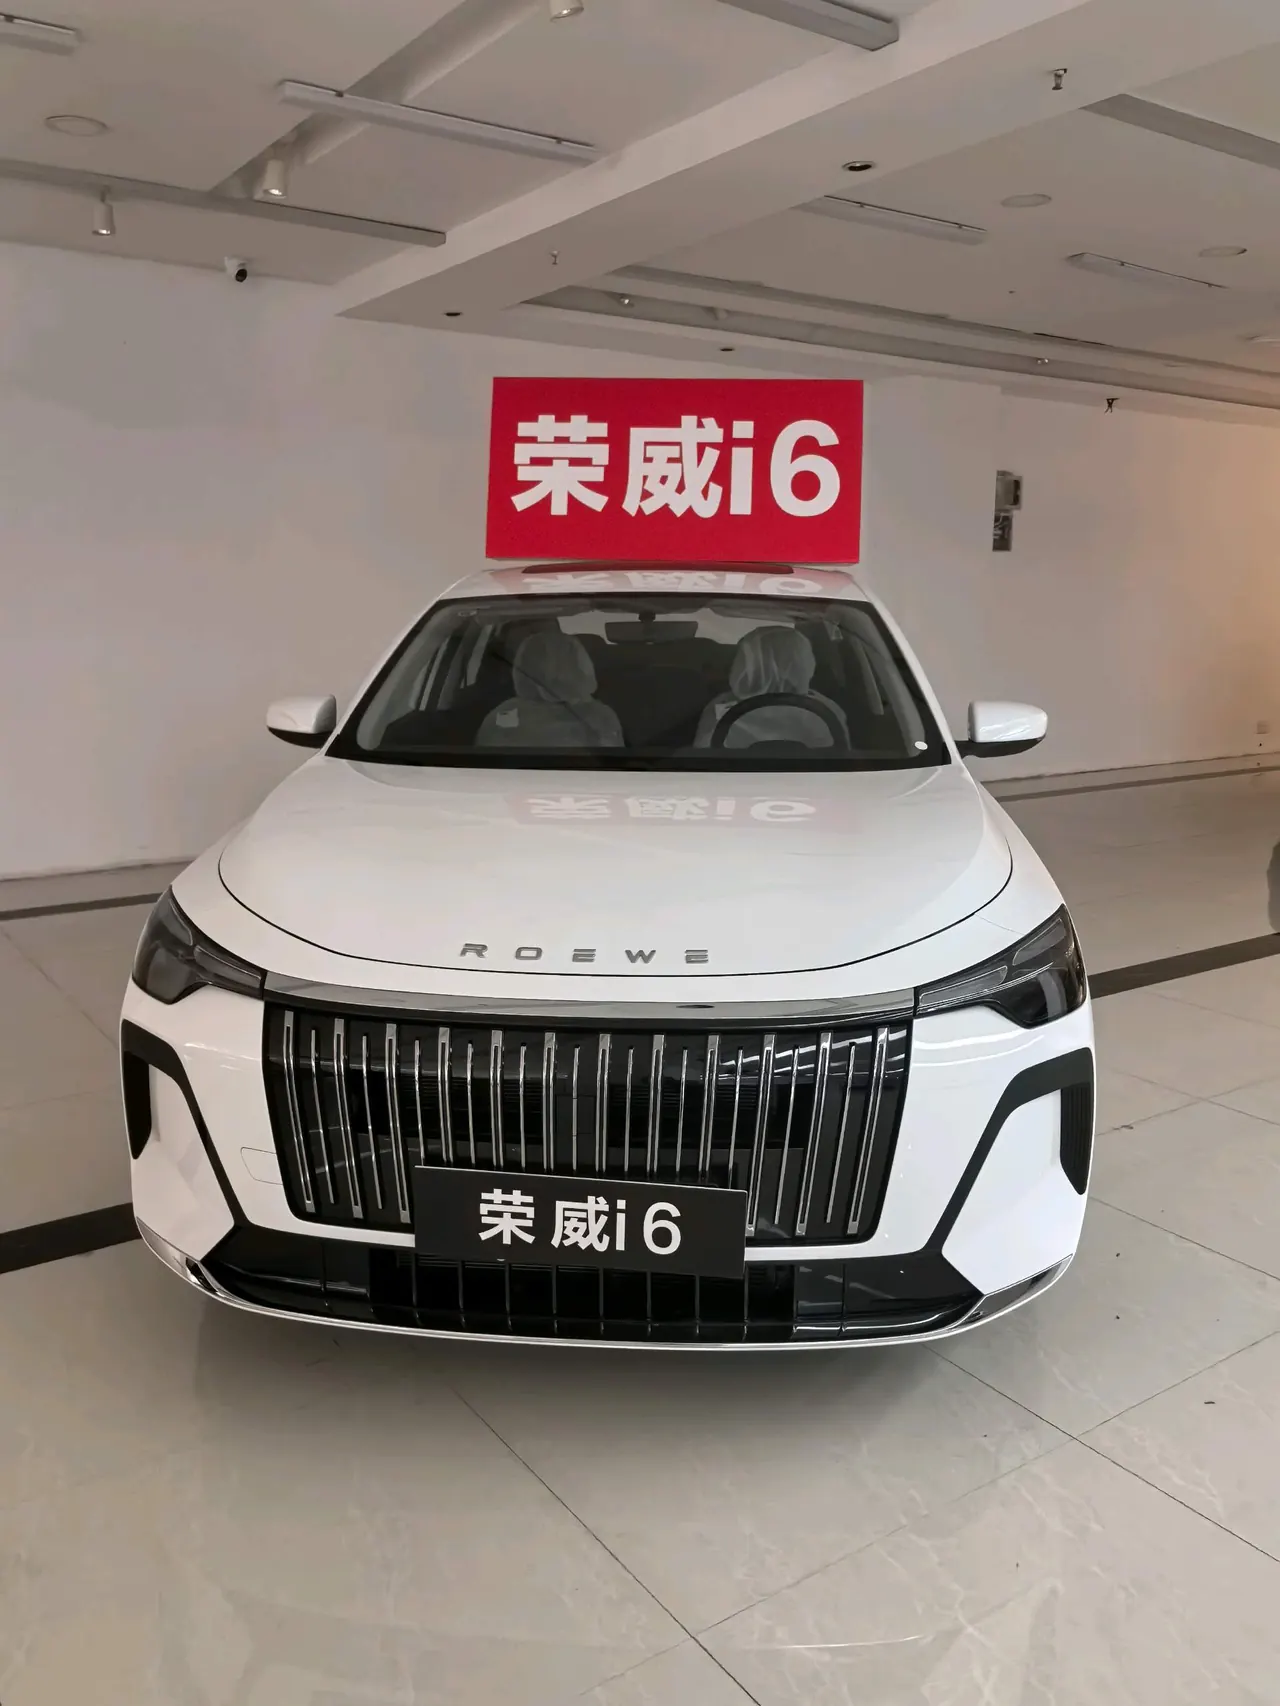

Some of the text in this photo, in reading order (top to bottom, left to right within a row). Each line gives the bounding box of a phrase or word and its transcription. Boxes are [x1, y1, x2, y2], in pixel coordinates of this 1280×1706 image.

[511, 415, 840, 518] 荣威i6
[460, 943, 708, 964] ROEWE
[479, 1188, 682, 1255] 荣威i6
